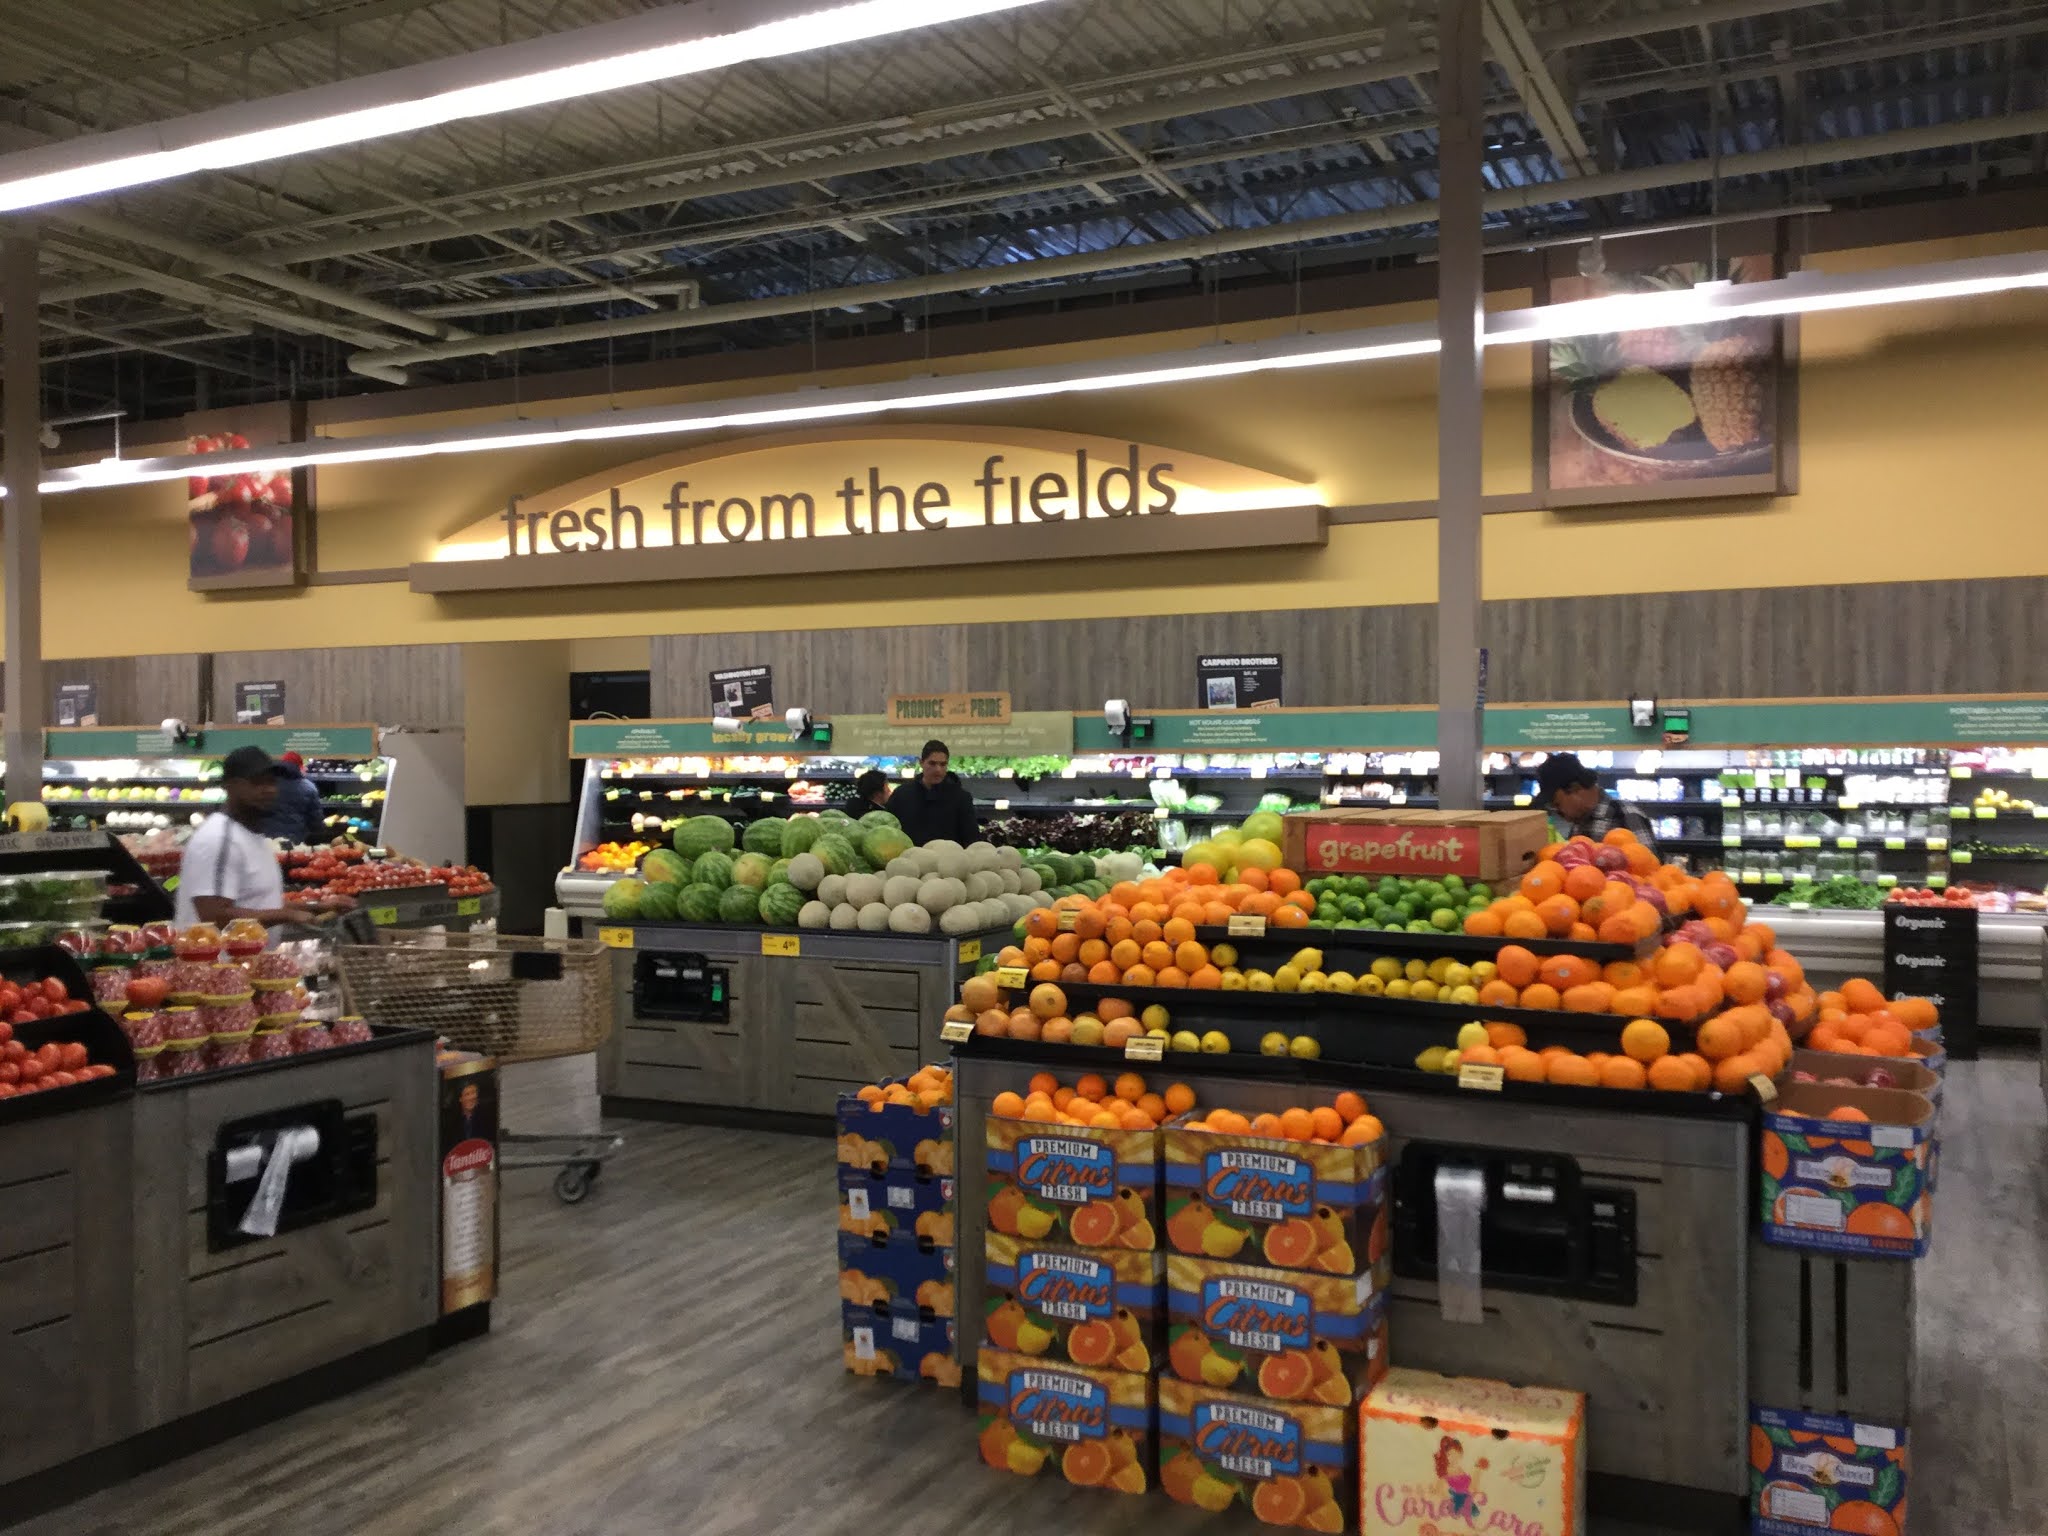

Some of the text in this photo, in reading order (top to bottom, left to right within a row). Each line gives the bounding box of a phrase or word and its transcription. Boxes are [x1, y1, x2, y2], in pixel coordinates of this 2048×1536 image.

[501, 444, 1176, 556] fresh from the fields
[1202, 657, 1278, 667] CARPINITO BROTHERS
[896, 699, 944, 719] PRODUCE
[970, 698, 1003, 718] PRIDE
[712, 731, 752, 744] locally
[1319, 831, 1464, 868] grapefruit
[1895, 915, 1946, 930] Organic
[1895, 954, 1947, 968] Organic
[1035, 1140, 1092, 1158] PREMIUM
[1019, 1153, 1110, 1188] Citrus
[1227, 1153, 1288, 1173] PREMIUM
[1046, 1186, 1082, 1200] FRESH
[1207, 1166, 1308, 1204] Citrus
[1237, 1200, 1277, 1218] FRESH
[1038, 1255, 1092, 1274] PREMIUM
[1019, 1268, 1109, 1306] Citrus
[1226, 1281, 1287, 1304] PREMIUM
[1046, 1302, 1081, 1318] FRESH
[1205, 1295, 1305, 1336] Citrus
[1235, 1331, 1275, 1349] FRESH
[1029, 1374, 1085, 1396] PREMIUM
[1010, 1388, 1102, 1427] Citrus
[1216, 1406, 1276, 1431] PREMIUM
[1037, 1421, 1074, 1438] FRESH
[1196, 1420, 1295, 1463] Citrus
[1225, 1456, 1266, 1475] FRESH
[1375, 1482, 1544, 1536] Cara Cara
